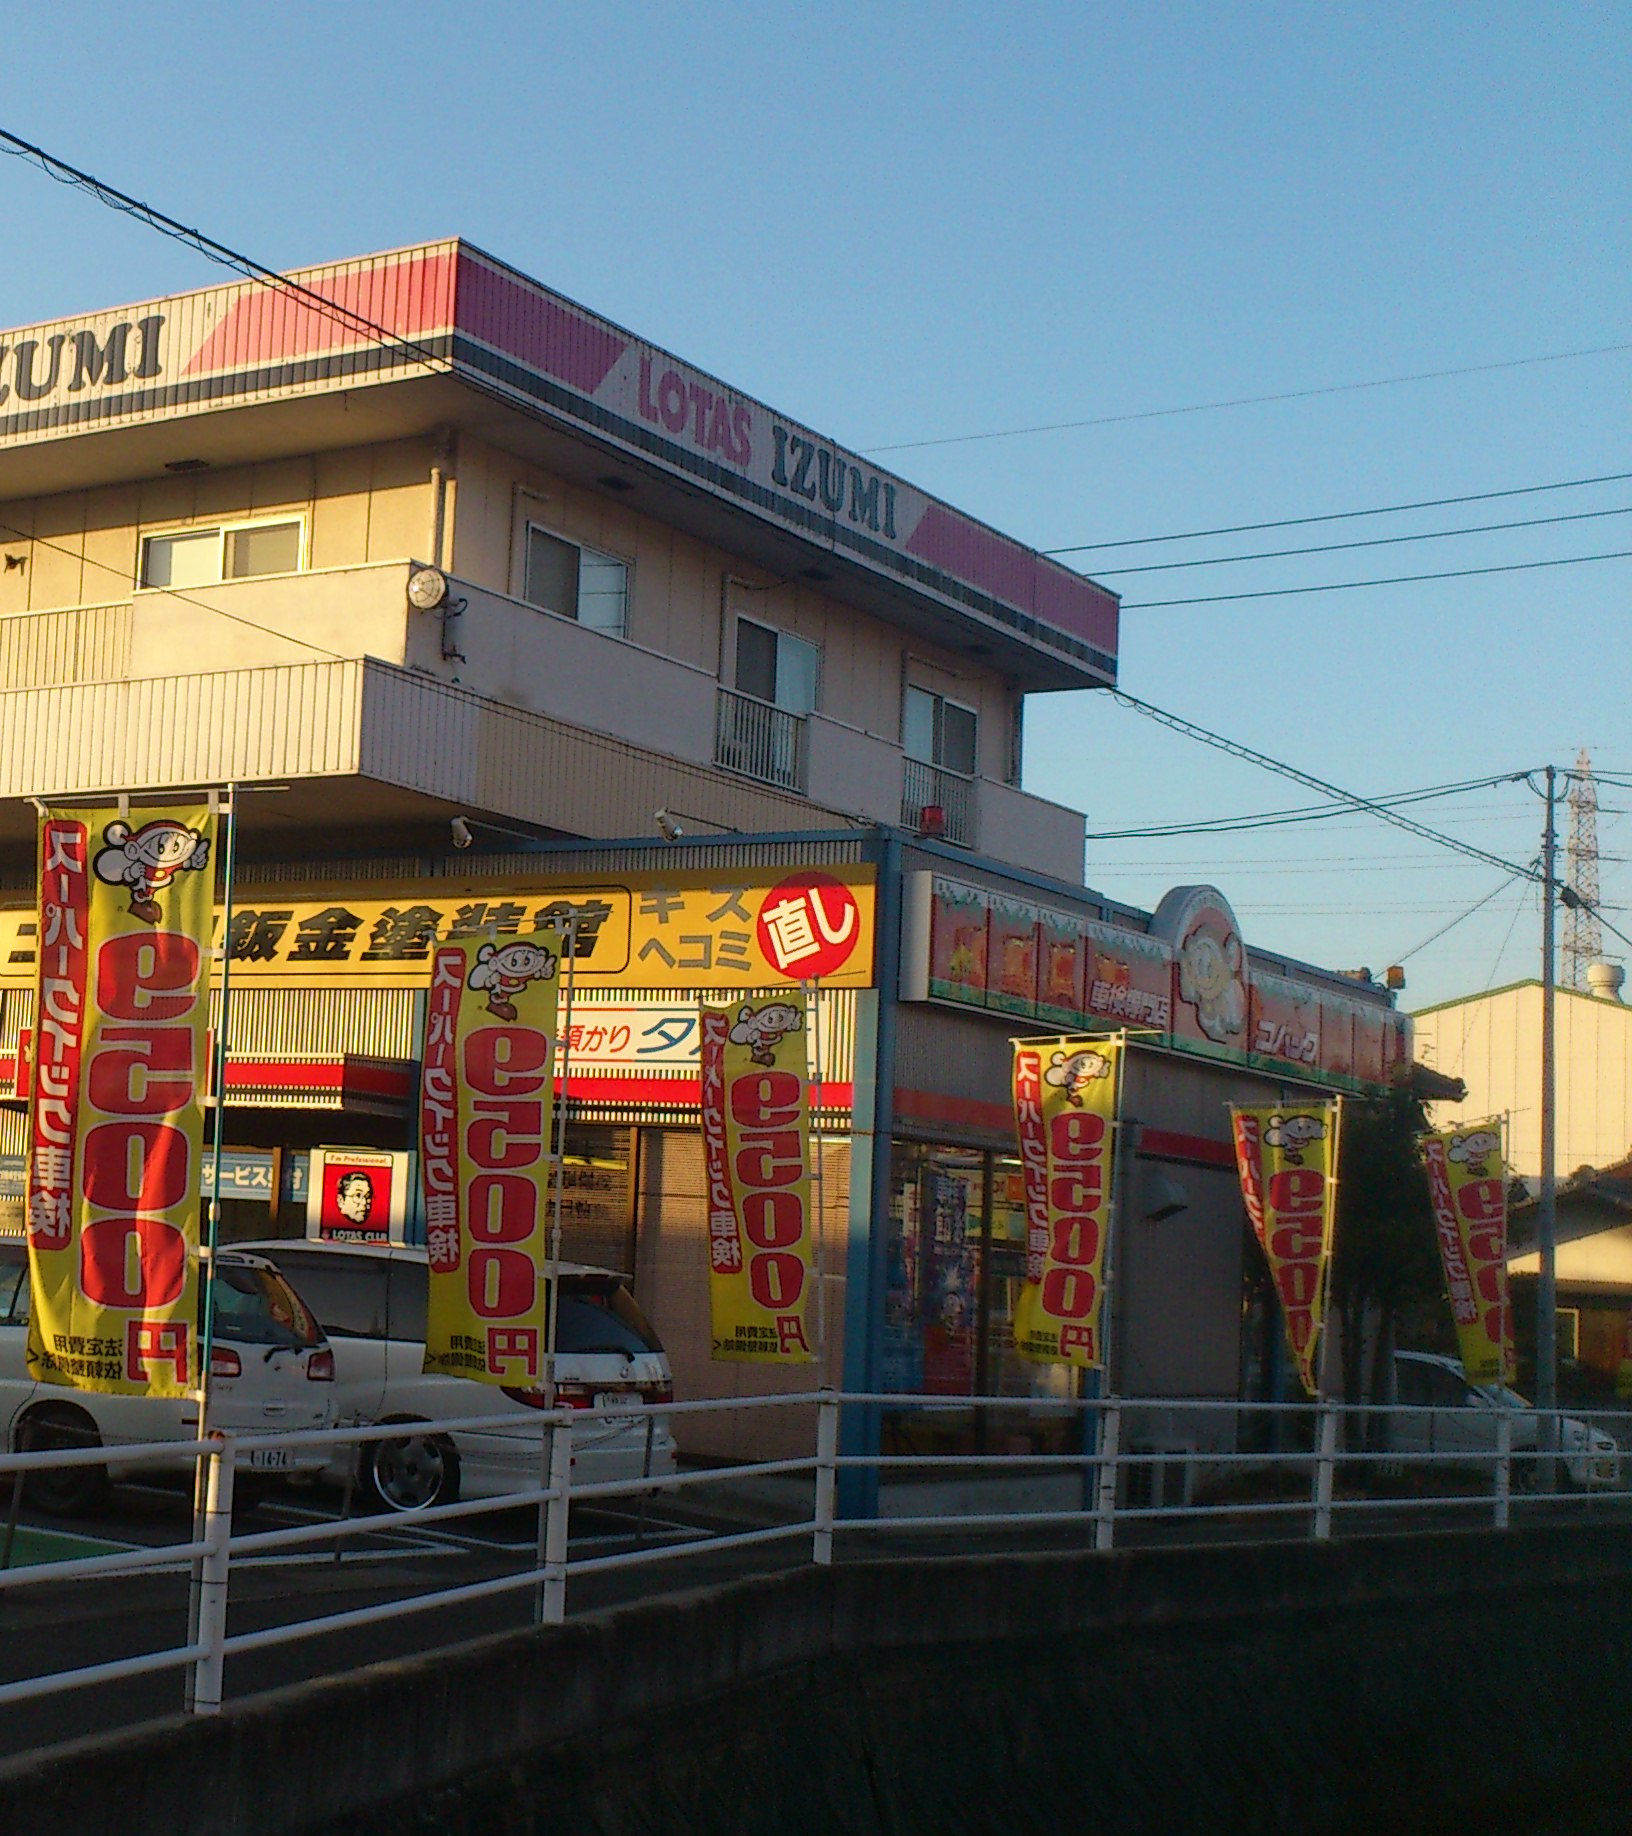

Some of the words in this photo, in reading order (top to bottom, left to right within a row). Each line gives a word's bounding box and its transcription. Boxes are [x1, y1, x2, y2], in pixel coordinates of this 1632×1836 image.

[636, 354, 753, 468] LOTAS
[771, 424, 898, 541] IZUMI
[639, 886, 753, 924] キズ
[762, 888, 855, 970] 直し
[638, 930, 753, 972] ヘコミ
[202, 1163, 303, 1191] サービス付
[332, 1229, 363, 1241] LOTAS
